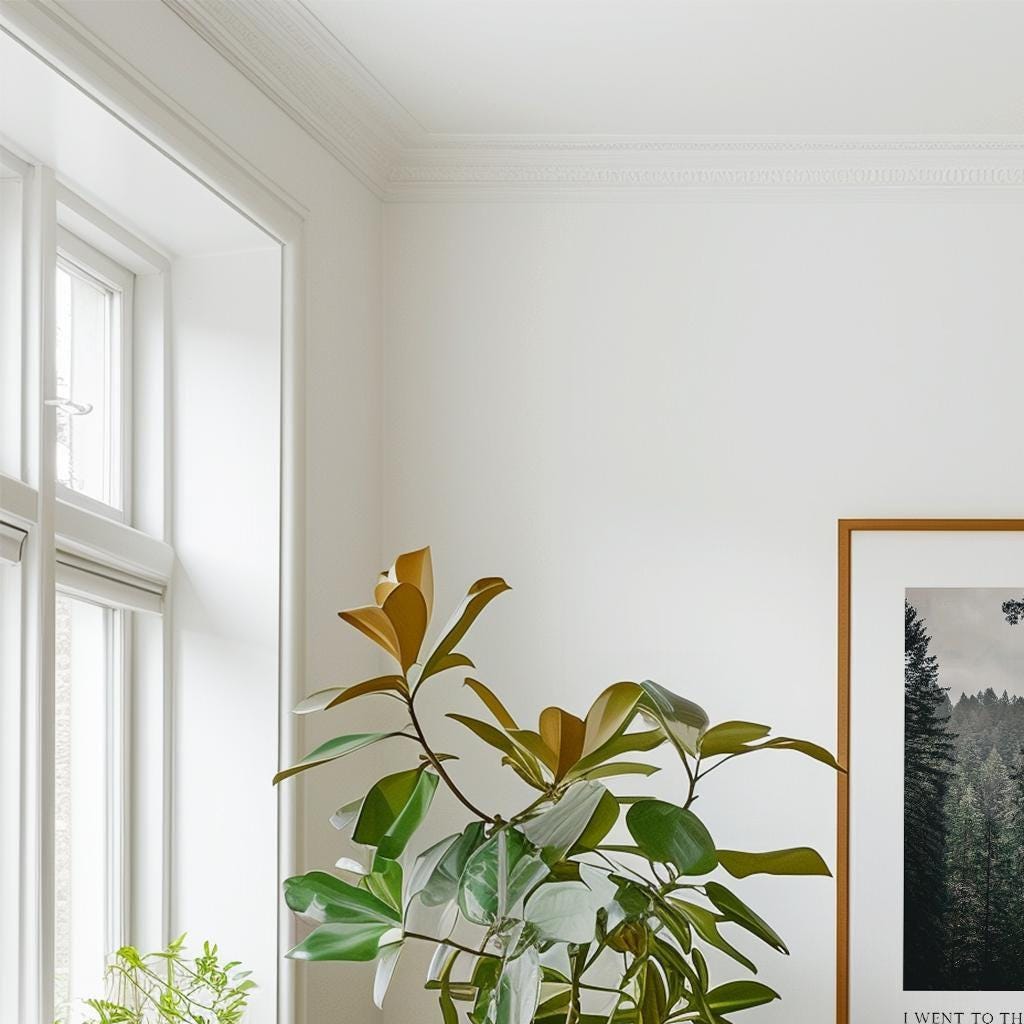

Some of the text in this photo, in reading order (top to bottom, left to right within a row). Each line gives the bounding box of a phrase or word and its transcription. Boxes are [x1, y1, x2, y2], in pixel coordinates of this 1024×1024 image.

[903, 1012, 908, 1024] I
[914, 1012, 965, 1024] WENT
[970, 1012, 994, 1024] TO
